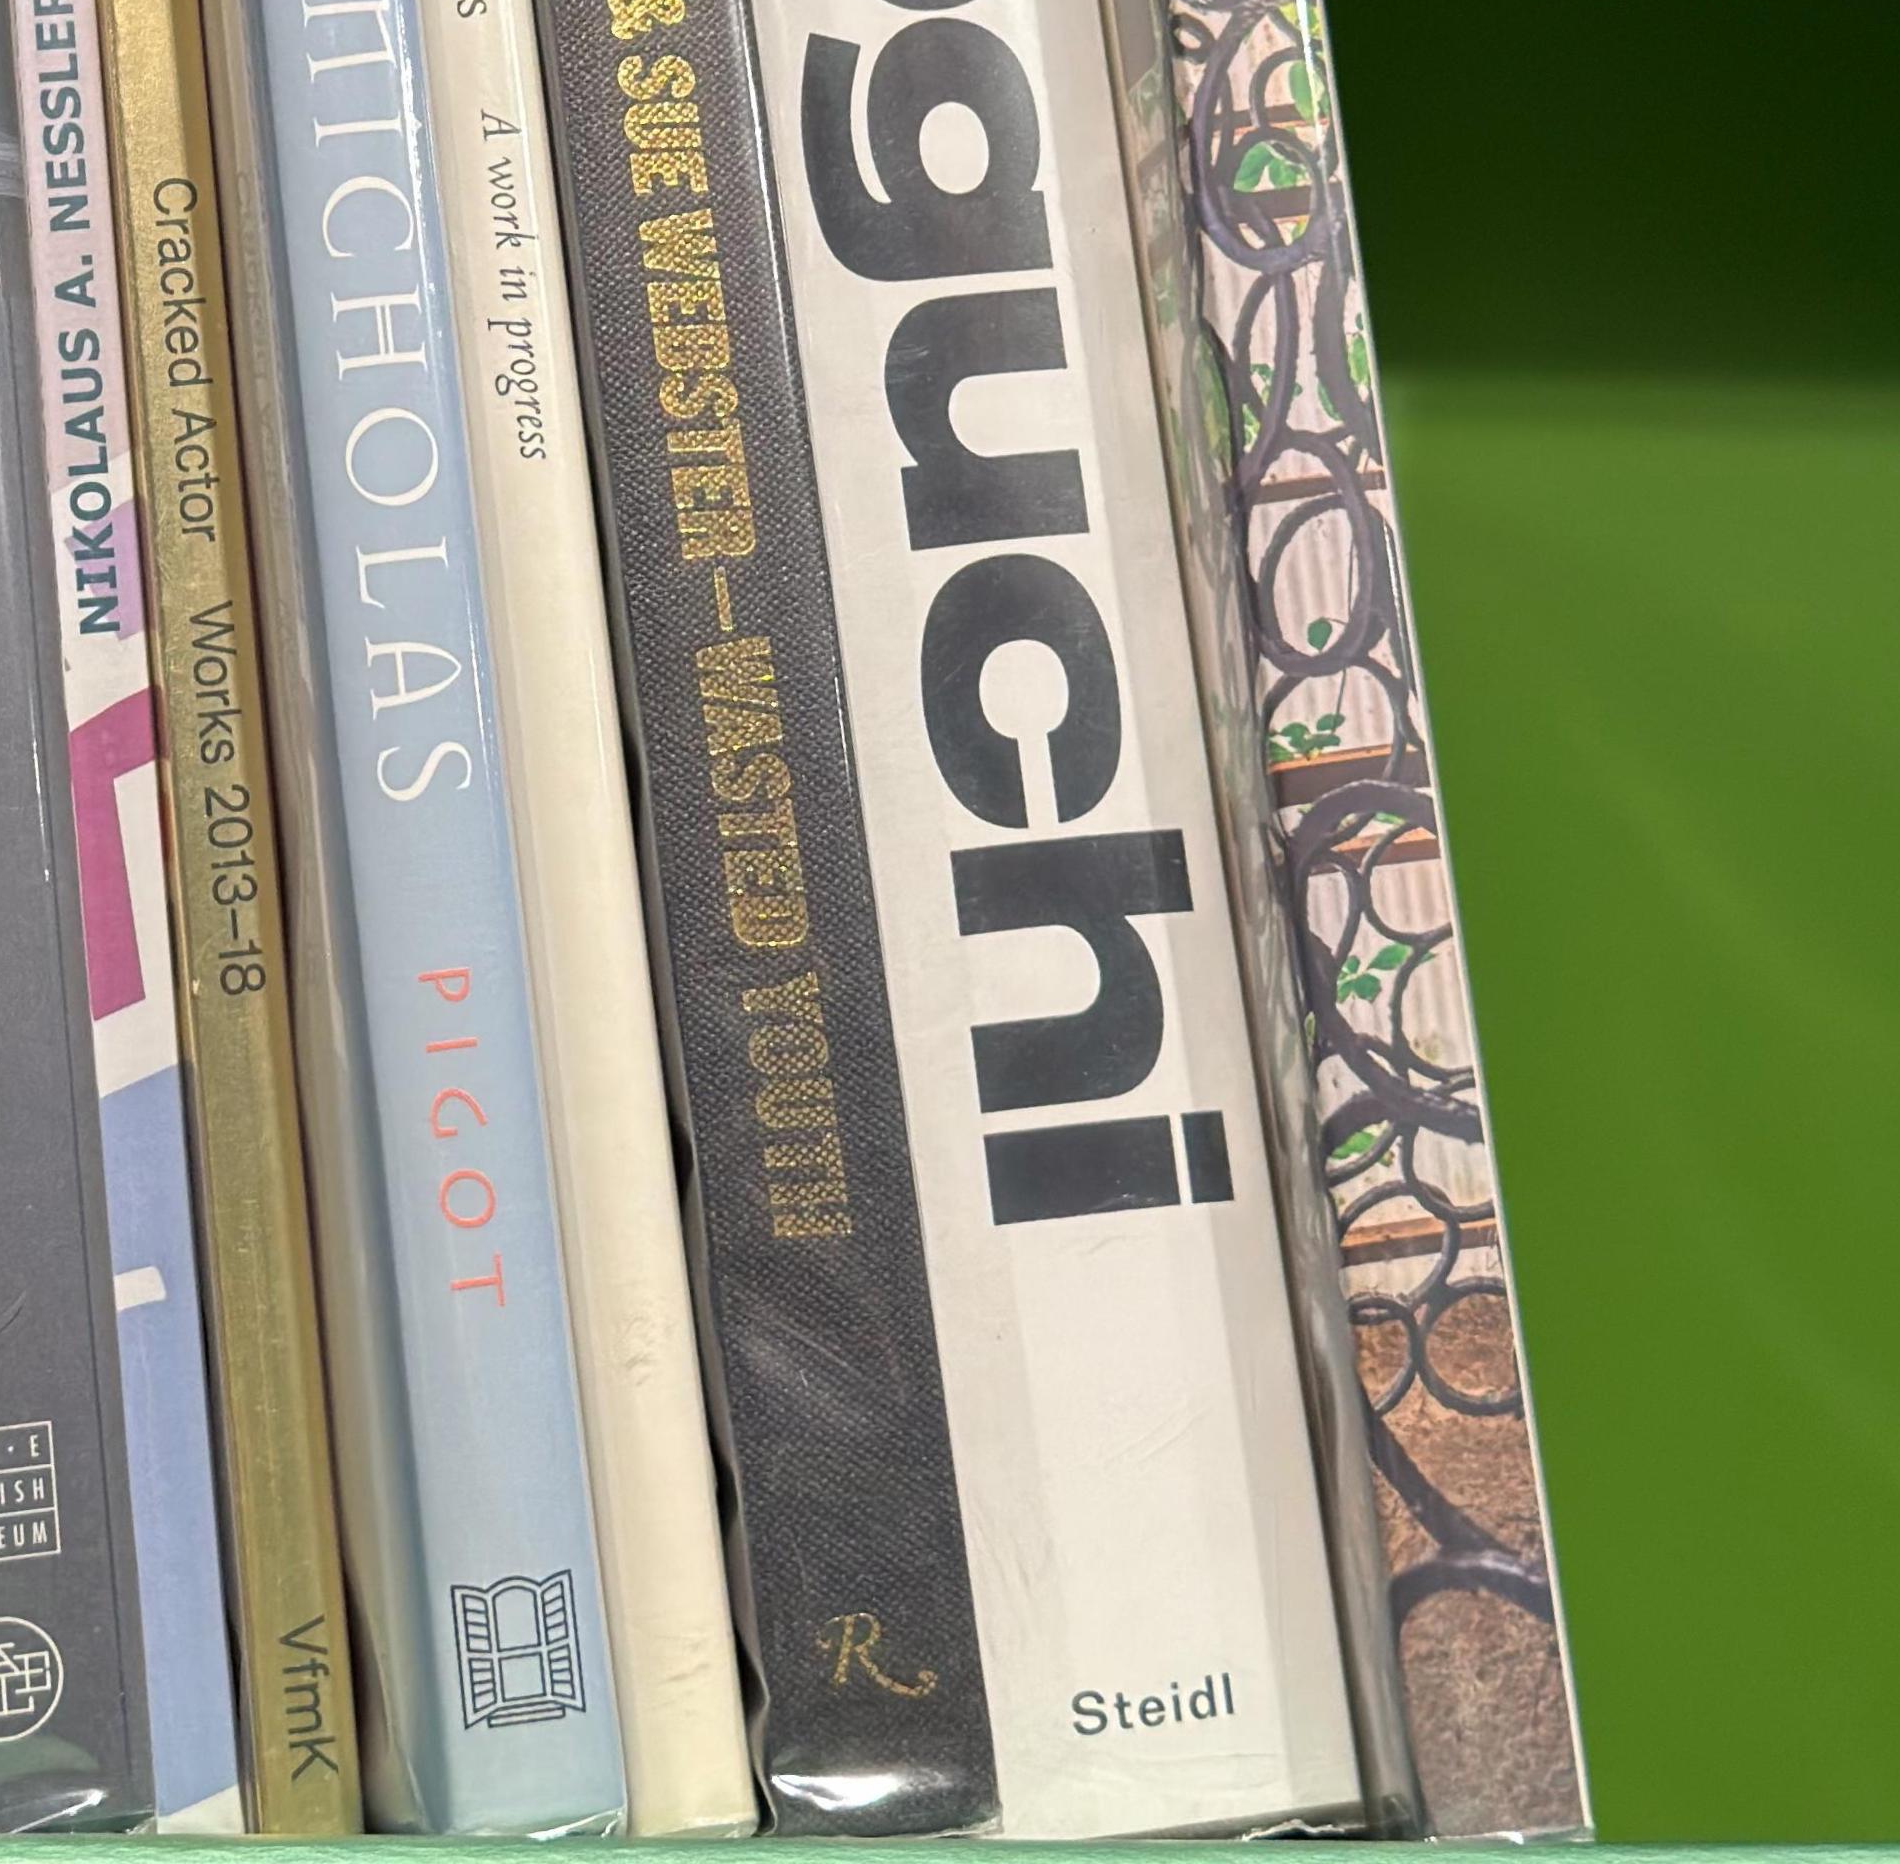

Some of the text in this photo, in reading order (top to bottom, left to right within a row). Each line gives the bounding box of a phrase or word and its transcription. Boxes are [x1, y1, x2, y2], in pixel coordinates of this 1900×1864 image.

[480, 106, 523, 143] A
[485, 159, 527, 250] work
[54, 253, 96, 308] A.
[153, 177, 201, 389] Cracked
[499, 262, 535, 303] in
[487, 315, 548, 462] progress
[57, 329, 122, 635] NIKOLAUS
[169, 405, 220, 544] Actor
[188, 600, 235, 767] Works
[616, 52, 709, 197] SUE
[742, 971, 852, 1240] YOUTH
[418, 965, 507, 1308] PIGOT
[1071, 1672, 1236, 1737] Steidl
